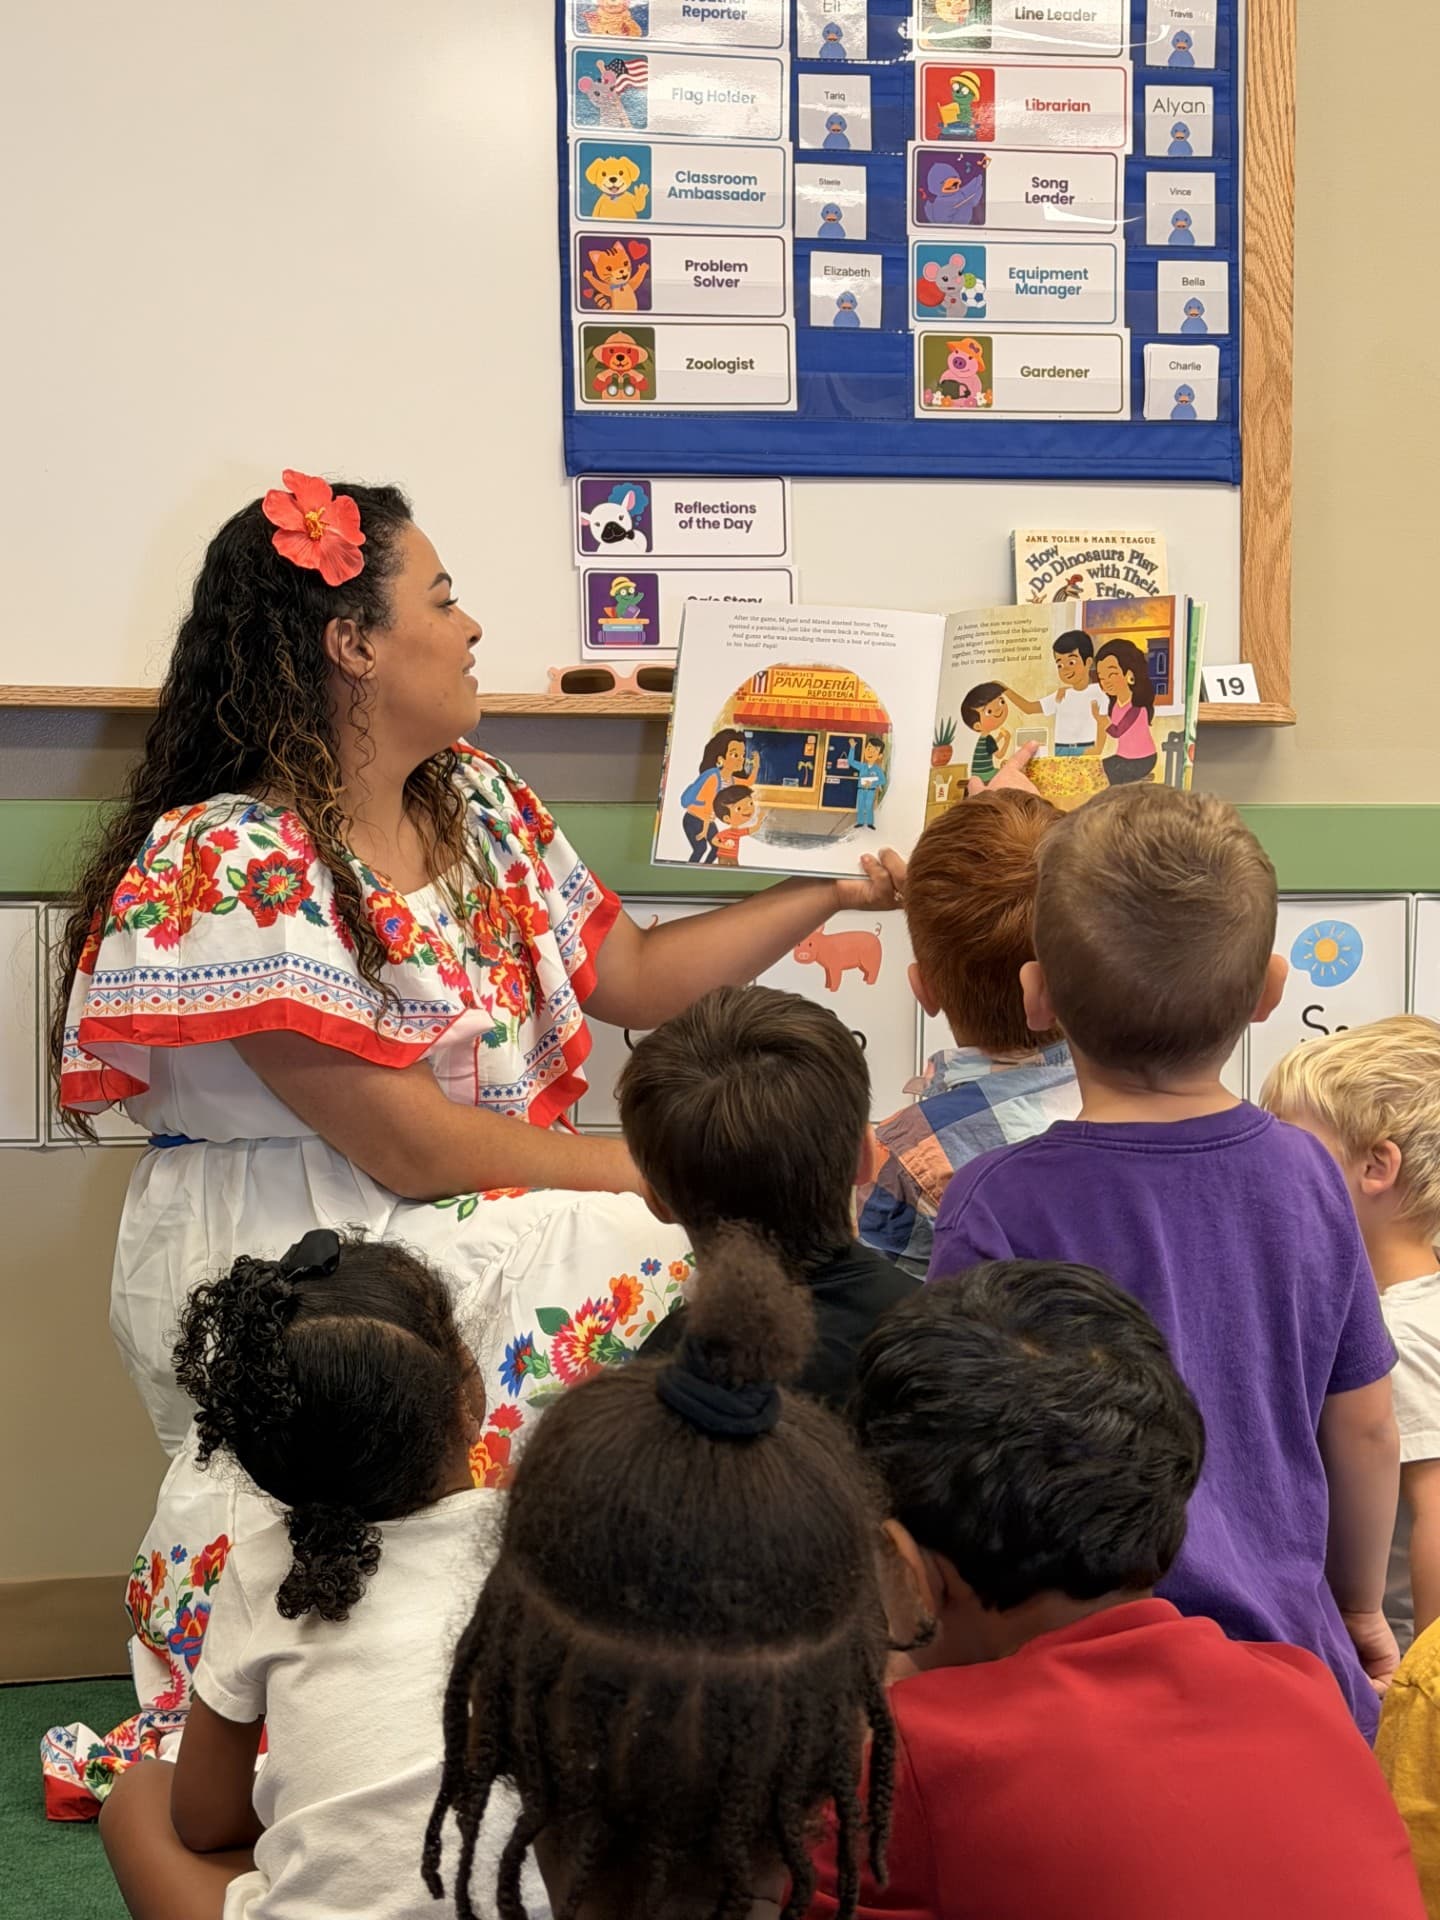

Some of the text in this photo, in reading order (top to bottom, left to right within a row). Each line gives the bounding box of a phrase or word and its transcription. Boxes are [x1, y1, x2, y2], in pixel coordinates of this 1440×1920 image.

[682, 5, 747, 21] Reporter
[1015, 6, 1097, 22] Line Leader
[671, 87, 756, 104] Flag Holder
[824, 91, 846, 102] Tariq
[1025, 98, 1091, 113] Librarian
[1152, 97, 1205, 117] Alyan
[675, 170, 757, 186] Classroom
[1031, 176, 1069, 192] Song
[667, 186, 766, 202] Ambassador
[1025, 191, 1075, 205] Leader
[1169, 187, 1191, 196] Vince
[684, 259, 748, 273] Problem
[823, 265, 871, 278] Elizabeth
[693, 275, 740, 288] Solver
[1008, 267, 1089, 282] Equipment
[1181, 277, 1205, 287] Bella
[1015, 283, 1082, 299] Manager
[685, 357, 755, 374] Zoologist
[1020, 365, 1090, 379] Gardener
[1169, 361, 1202, 371] Charlie
[674, 501, 757, 514] Reflections
[679, 517, 753, 533] of the Day
[1025, 535, 1048, 543] JANE
[1091, 536, 1117, 544] MARK
[1025, 545, 1059, 571] How
[1029, 548, 1159, 593] Do Dinosaurs Play
[1086, 563, 1160, 597] with Their
[1095, 581, 1136, 599] Frien
[774, 676, 855, 690] PANADERÍA
[1216, 677, 1245, 697] 19
